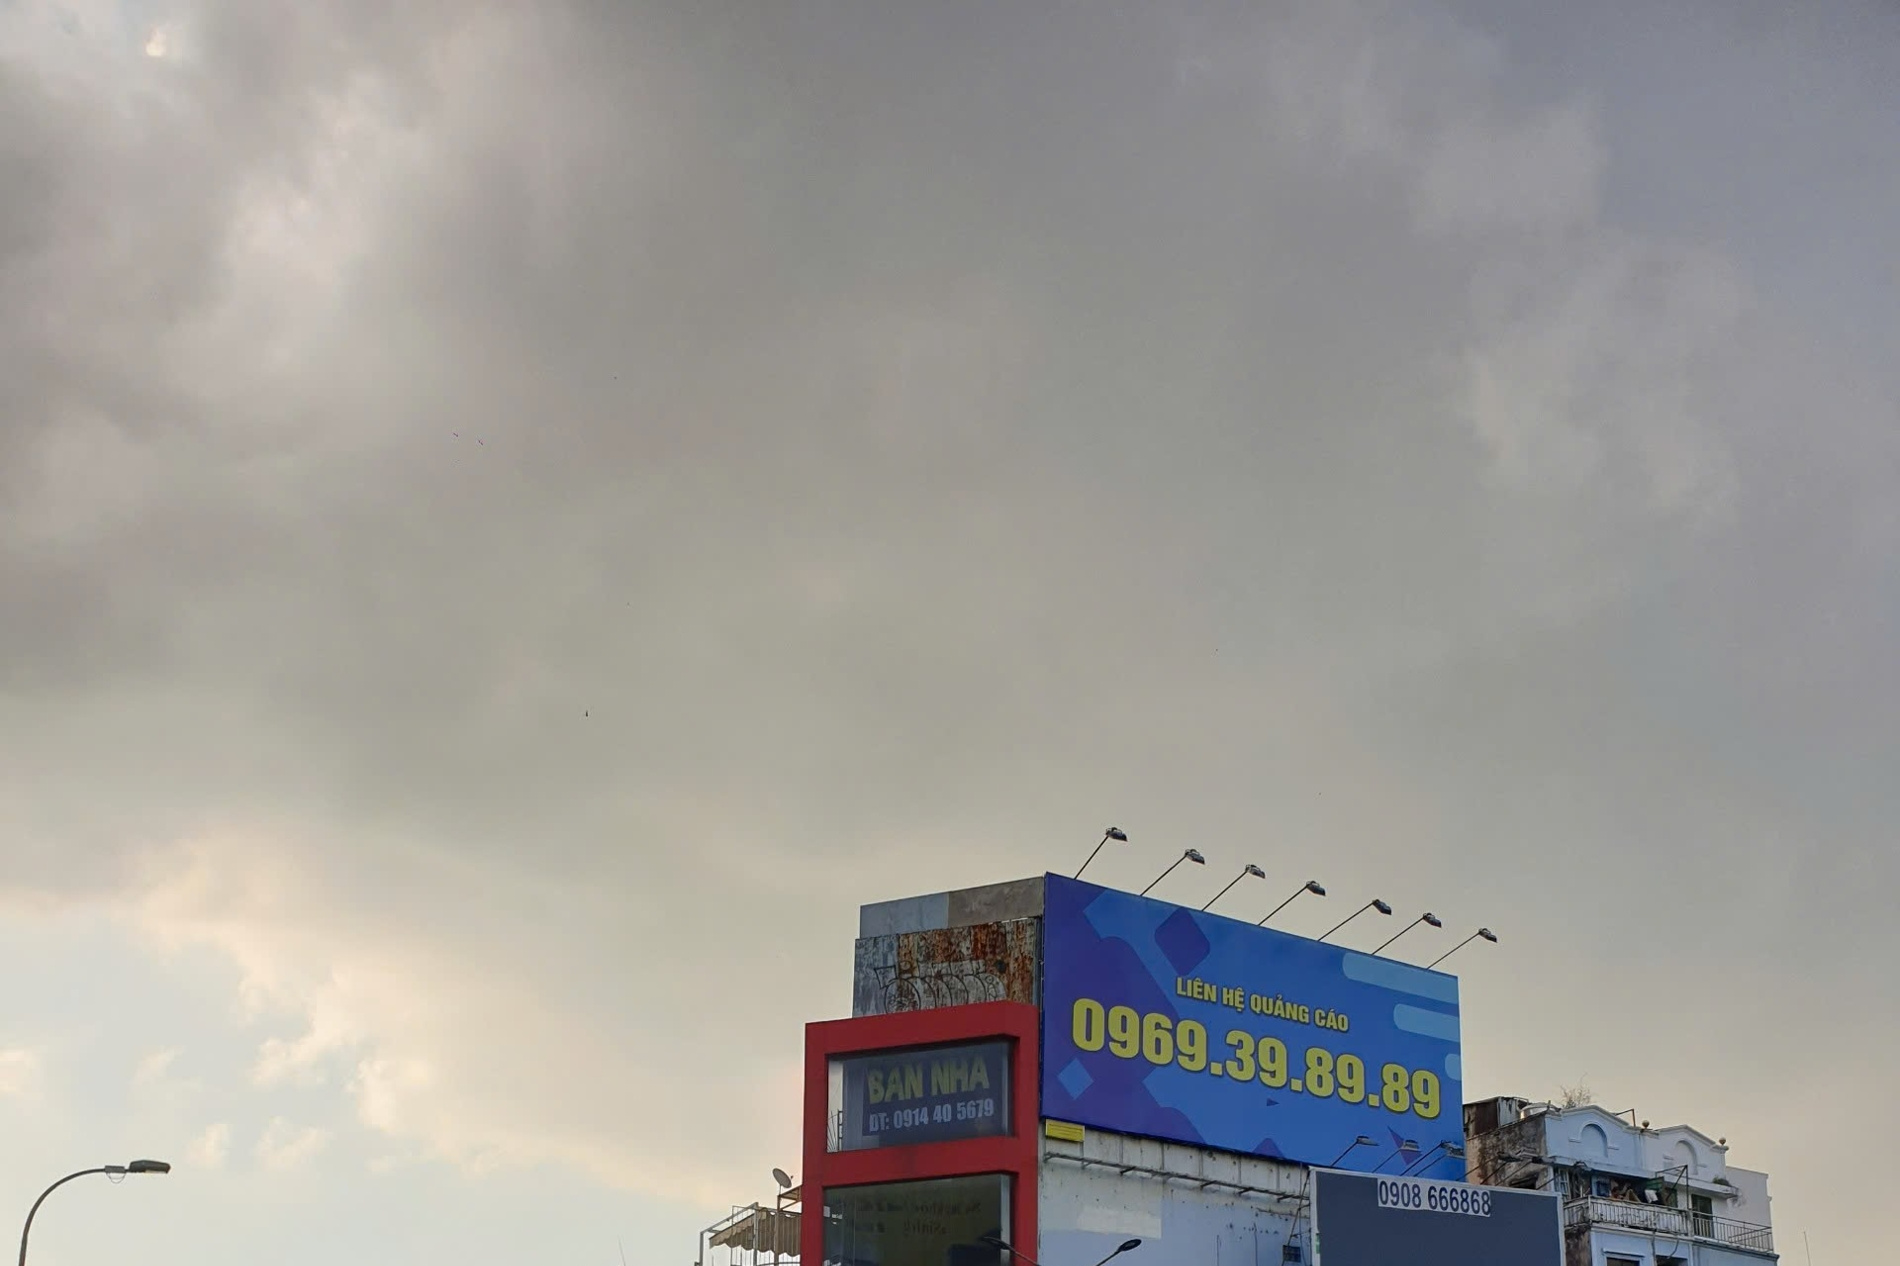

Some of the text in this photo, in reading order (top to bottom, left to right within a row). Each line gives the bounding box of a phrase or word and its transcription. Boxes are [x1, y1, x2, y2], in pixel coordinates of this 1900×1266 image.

[1175, 976, 1349, 1032] LIÊN HỆ QUẢNG CÁO
[1071, 997, 1441, 1119] 0969.39.89.89
[893, 1106, 929, 1129] 0914
[932, 1103, 952, 1123] 40
[956, 1098, 995, 1121] 5679
[1378, 1180, 1492, 1216] 0908 666868
